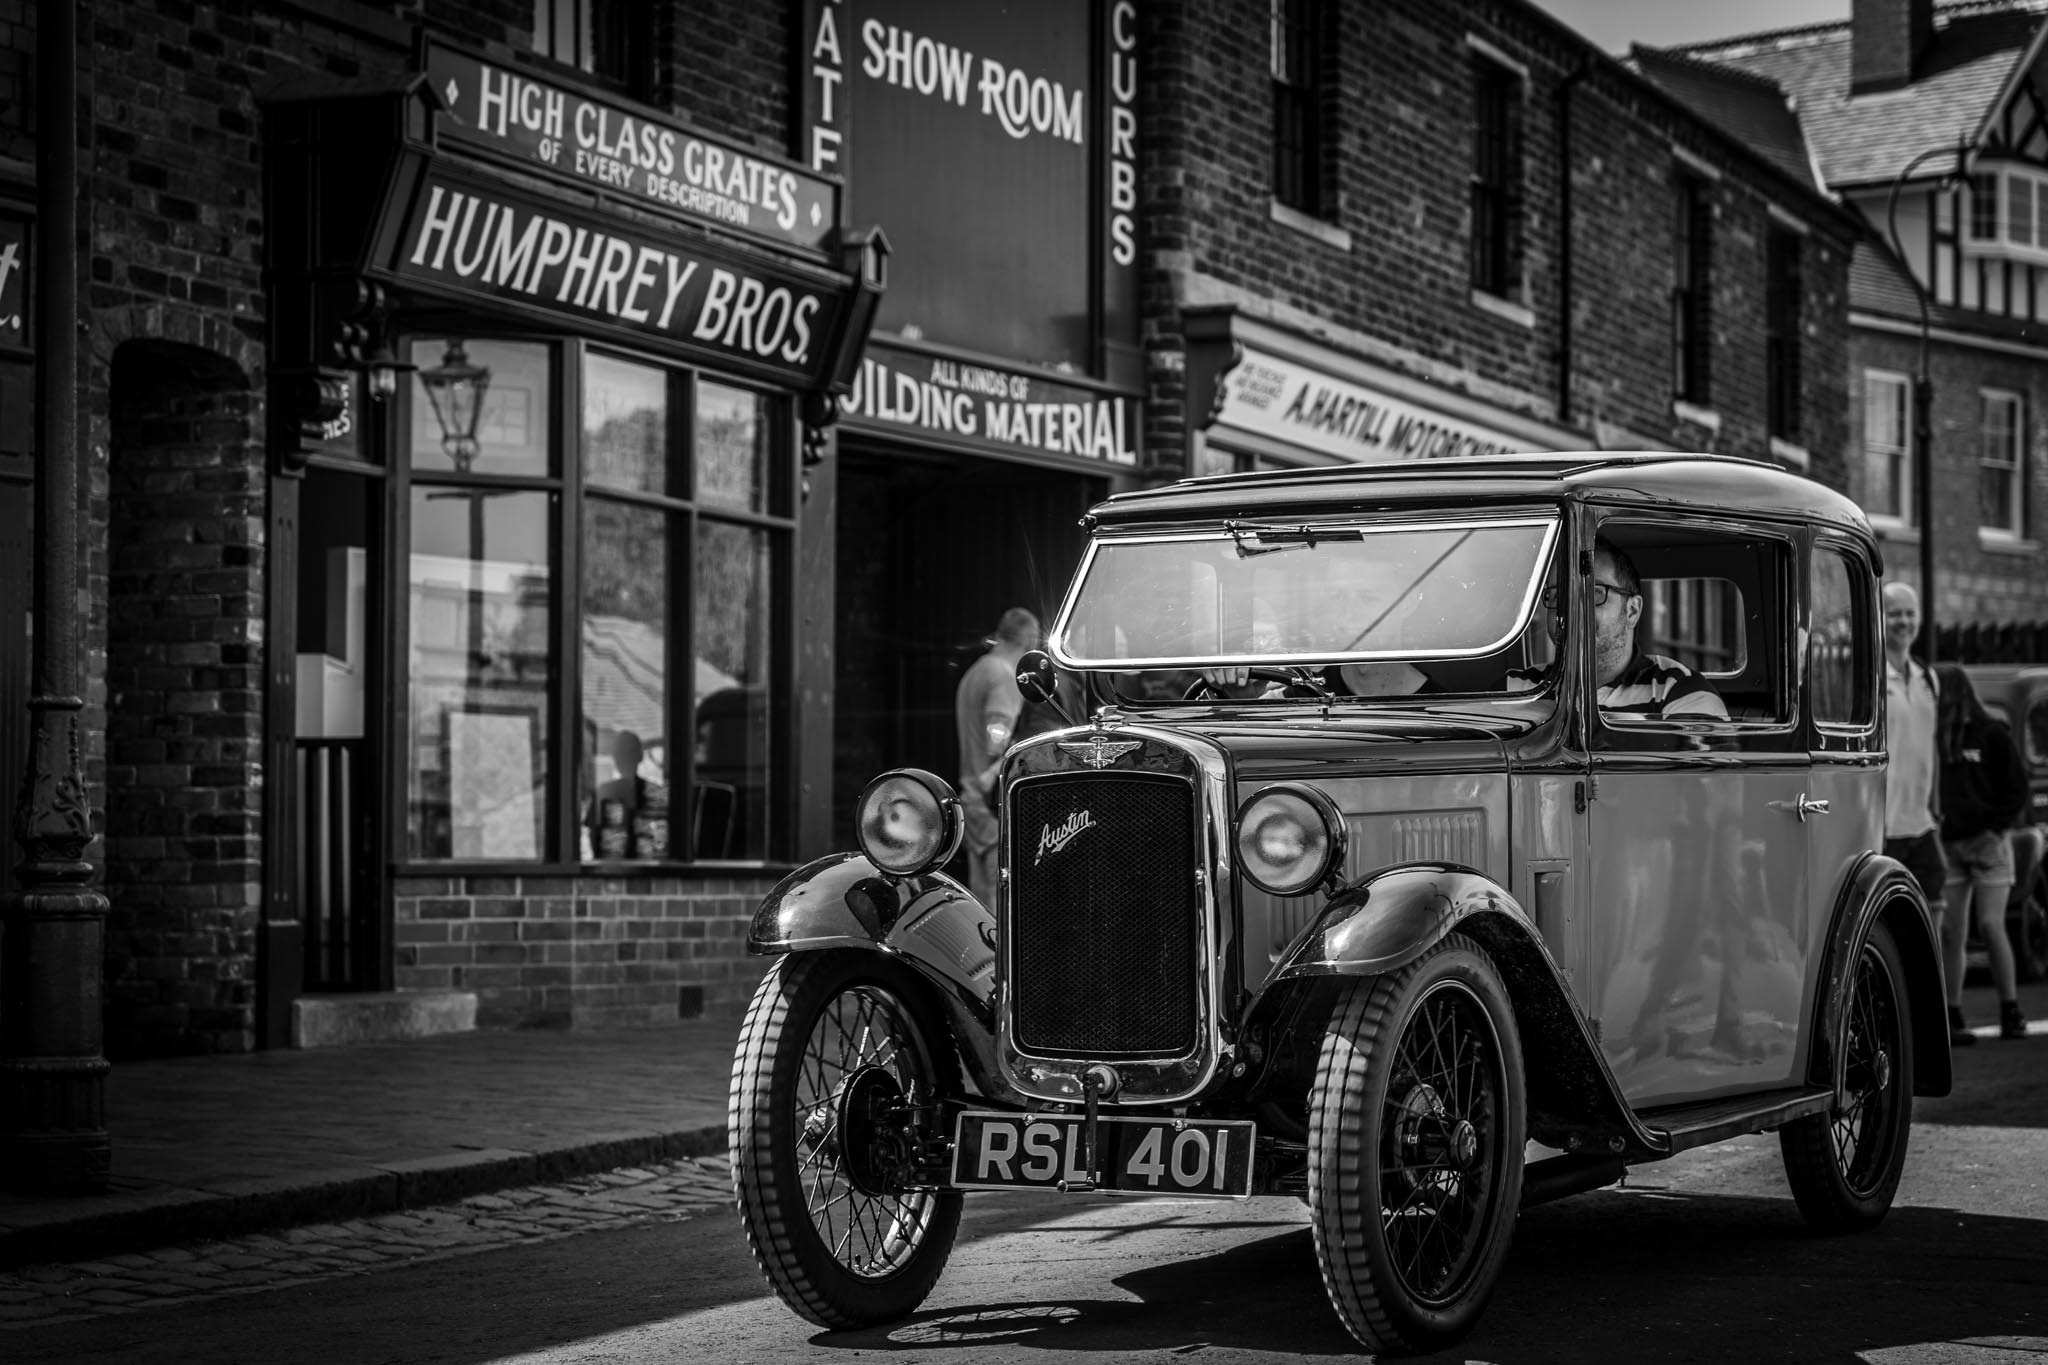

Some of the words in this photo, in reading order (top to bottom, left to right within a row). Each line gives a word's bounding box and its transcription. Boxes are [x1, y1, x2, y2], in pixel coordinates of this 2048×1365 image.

[812, 0, 842, 172] ATE
[862, 18, 973, 106] SHOW
[978, 58, 1083, 144] ROOM
[1112, 1, 1137, 266] CURBS
[478, 65, 565, 139] HIGH
[575, 102, 675, 175] CLASS
[683, 139, 798, 231] GRATES
[538, 138, 562, 165] OF
[575, 150, 634, 188] EVERY
[647, 173, 749, 226] DESCRIPTION
[410, 186, 698, 328] HUMPHREY
[693, 268, 820, 364] BROS.
[838, 358, 976, 435] UILDING
[985, 397, 1136, 465] MATERIAL
[930, 358, 959, 388] ALL
[960, 365, 1008, 398] KINDS
[1009, 374, 1030, 401] OF
[1034, 809, 1096, 866] Austin
[977, 1121, 1100, 1184] RSL
[1126, 1127, 1228, 1190] 401
